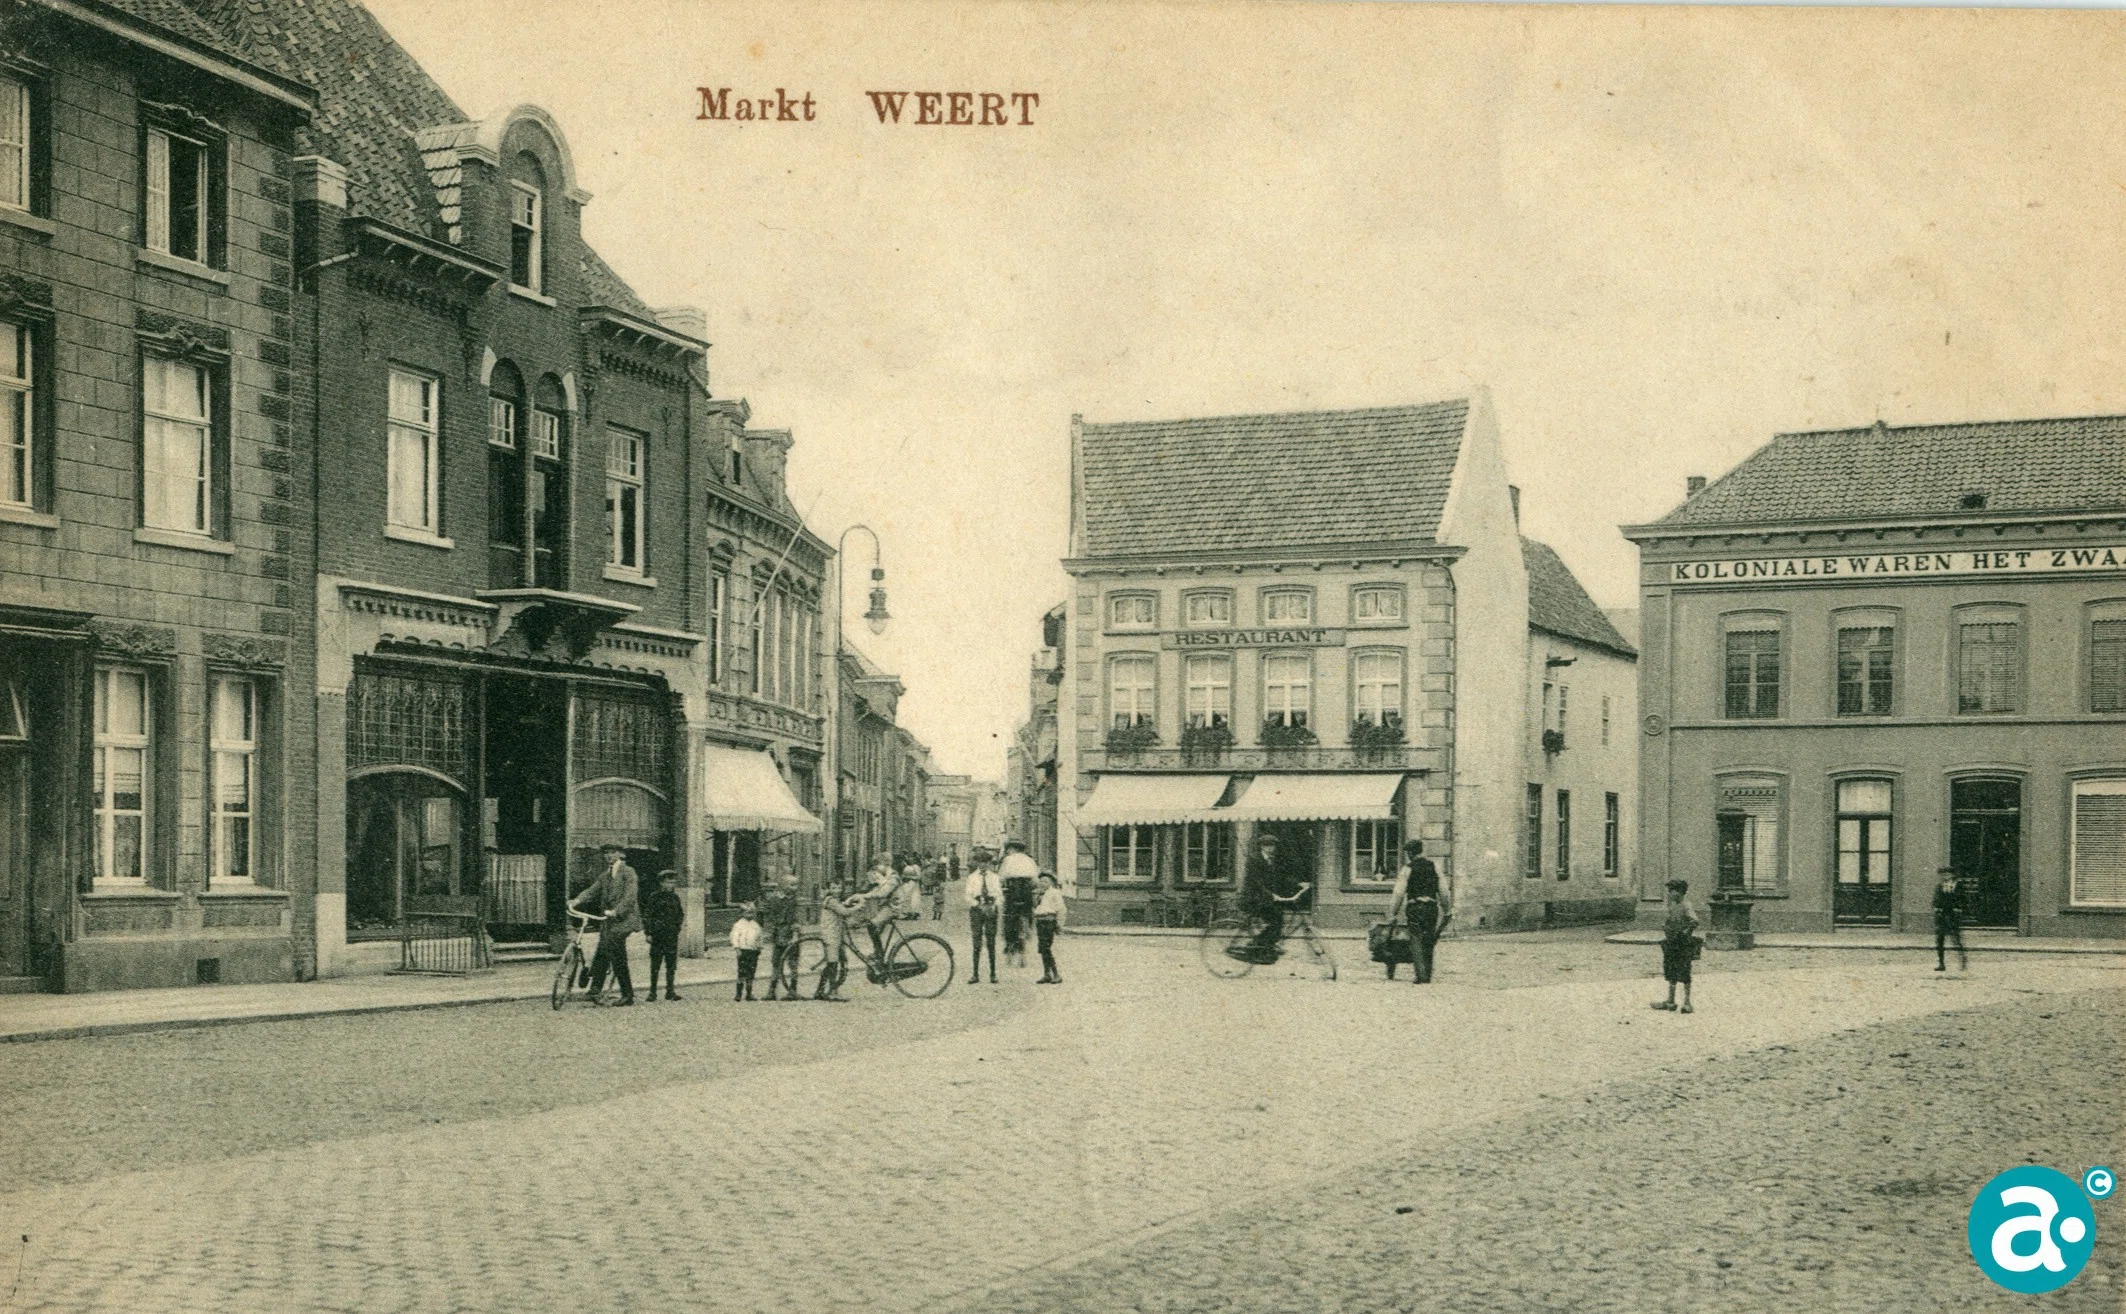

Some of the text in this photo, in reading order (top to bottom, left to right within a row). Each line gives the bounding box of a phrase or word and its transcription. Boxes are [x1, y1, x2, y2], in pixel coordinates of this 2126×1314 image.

[1676, 549, 2126, 580] KOLONIALE WAREN HET ZWA
[1174, 630, 1327, 646] RESTAURANT
